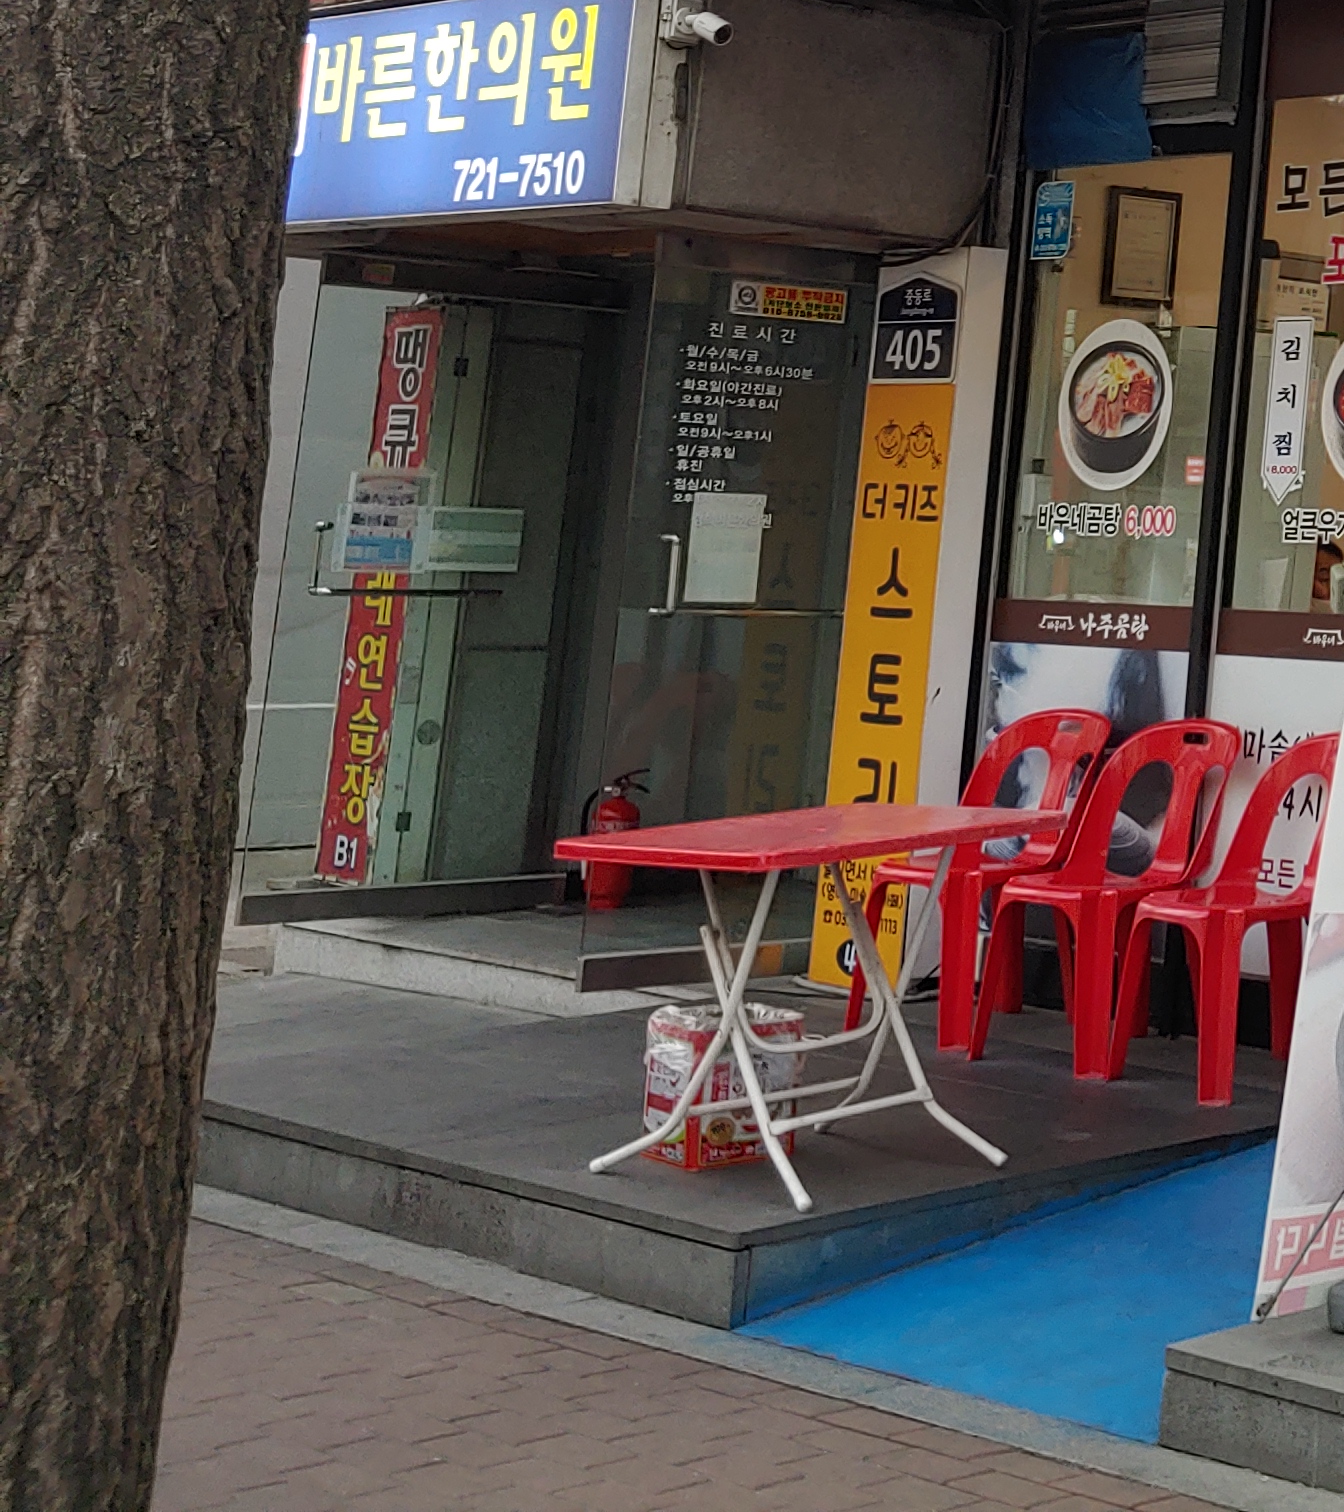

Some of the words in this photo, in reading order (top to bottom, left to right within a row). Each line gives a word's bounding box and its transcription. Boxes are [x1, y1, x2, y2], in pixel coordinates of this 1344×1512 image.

[311, 4, 601, 144] 바른한의원
[450, 148, 587, 203] 721-7510
[884, 328, 943, 372] 405
[1272, 334, 1302, 458] 김치찜
[861, 482, 941, 523] 더키즈
[1036, 503, 1122, 536] 바우네곰탕
[1124, 505, 1177, 538] 6,000
[1079, 613, 1150, 640] 나주곰탕
[333, 833, 360, 871] B1
